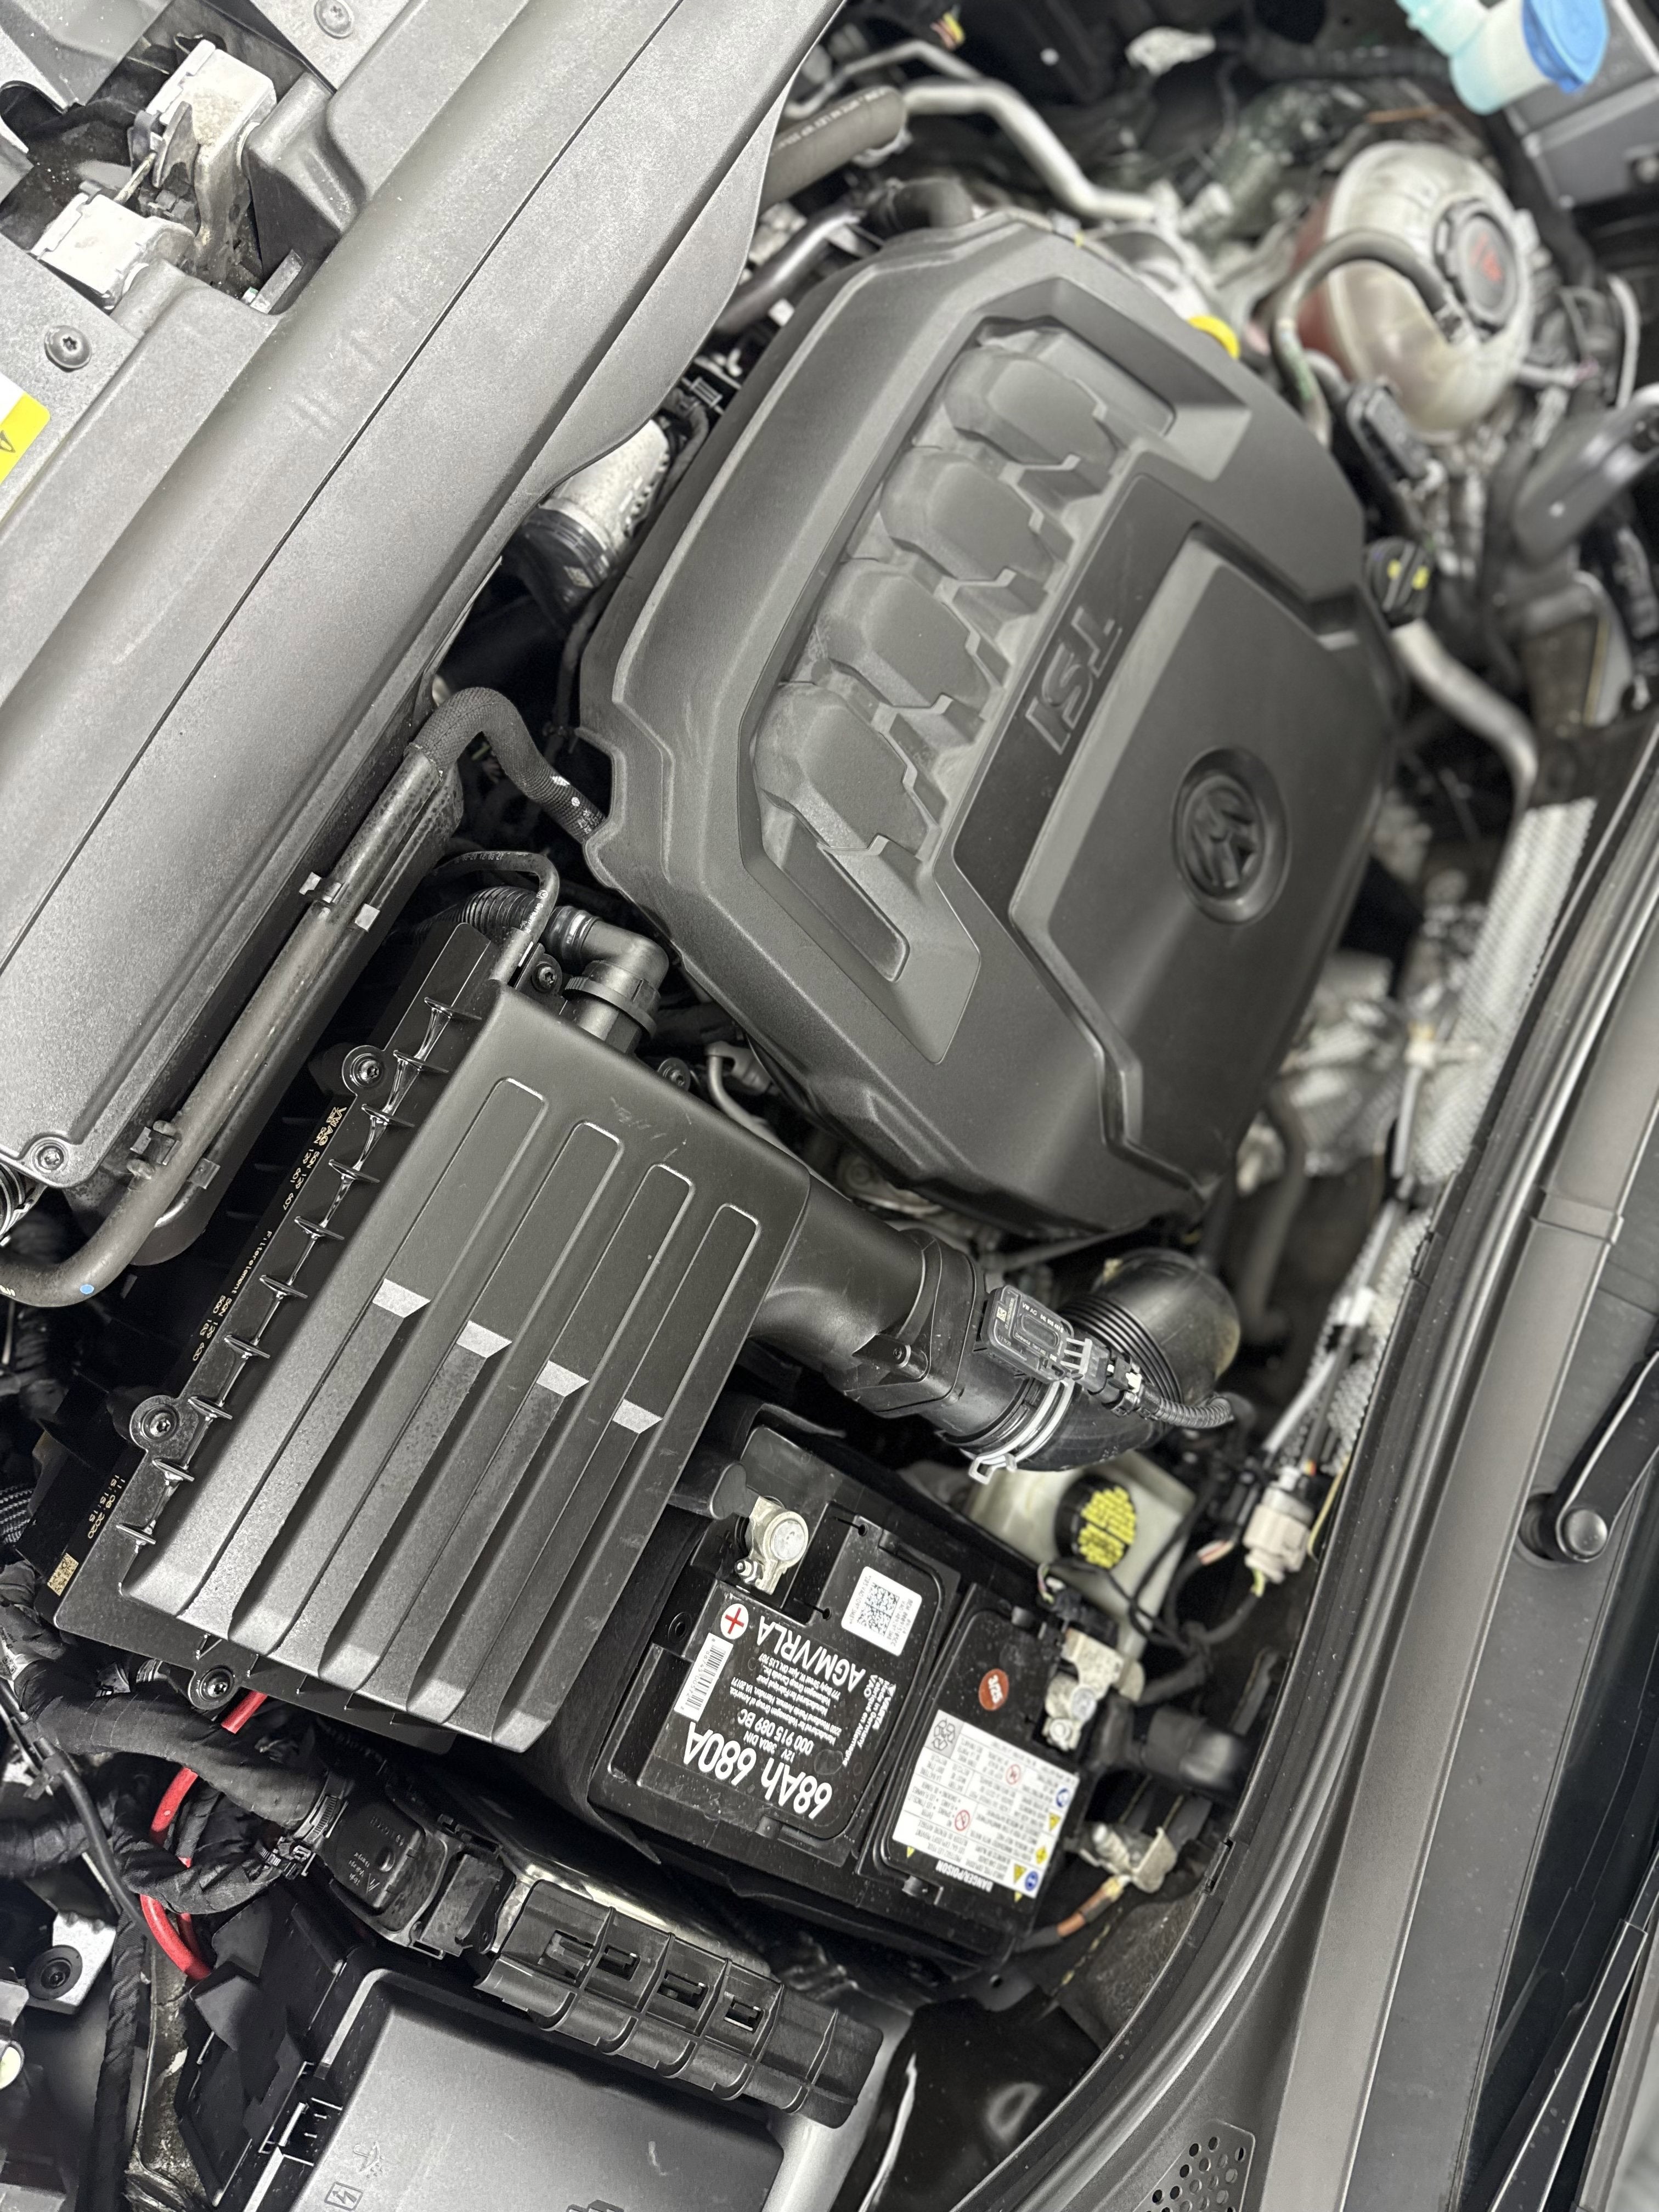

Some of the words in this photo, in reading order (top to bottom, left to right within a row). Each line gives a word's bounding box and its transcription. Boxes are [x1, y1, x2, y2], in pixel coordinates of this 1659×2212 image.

[1025, 605, 1123, 756] TSI
[527, 902, 544, 927] Germany
[313, 1126, 326, 1143] 5QN
[302, 1149, 314, 1164] 129
[306, 1151, 320, 1168] 5QN
[290, 1167, 301, 1182] 601
[295, 1173, 307, 1189] 129
[283, 1192, 294, 1210] 607
[232, 1231, 272, 1293] Filterelement
[218, 1297, 232, 1316] 5QN
[1020, 1302, 1031, 1312] VW
[1029, 1307, 1038, 1316] AG
[206, 1322, 218, 1339] 129
[192, 1342, 204, 1361] 620
[757, 1616, 865, 1690] AGM/VRLA
[756, 1674, 769, 1685] pour
[771, 1669, 789, 1686] Canada
[787, 1667, 800, 1679] Ajax
[805, 1675, 820, 1689] Street
[731, 1677, 747, 1690] 20171
[789, 1678, 804, 1693] Group
[877, 1680, 890, 1702] Made
[988, 1674, 1003, 1703] 3/25
[748, 1697, 756, 1706] of
[803, 1686, 834, 1706] Volkswagen
[830, 1689, 840, 1701] 777
[865, 1677, 884, 1712] Fabriqué
[755, 1698, 772, 1714] Group
[795, 1694, 828, 1716] Manufactured
[872, 1696, 891, 1729] VARTA
[873, 1702, 880, 1711] in
[737, 1708, 755, 1728] BC
[770, 1707, 798, 1727] Volkswagen
[797, 1720, 806, 1730] for
[806, 1713, 830, 1731] Woodland
[860, 1712, 867, 1723] en
[754, 1717, 775, 1737] 089
[774, 1726, 794, 1746] 915
[804, 1723, 836, 1745] Manufactured
[857, 1710, 876, 1748] Germany
[743, 1730, 759, 1746] DIN
[759, 1737, 777, 1754] 380A
[793, 1735, 814, 1755] 000
[842, 1723, 863, 1767] Allemagne
[684, 1721, 756, 1785] 680A
[780, 1748, 795, 1763] 12V
[761, 1758, 832, 1818] 68Ah
[935, 1860, 994, 1893] DANGER/POISON
